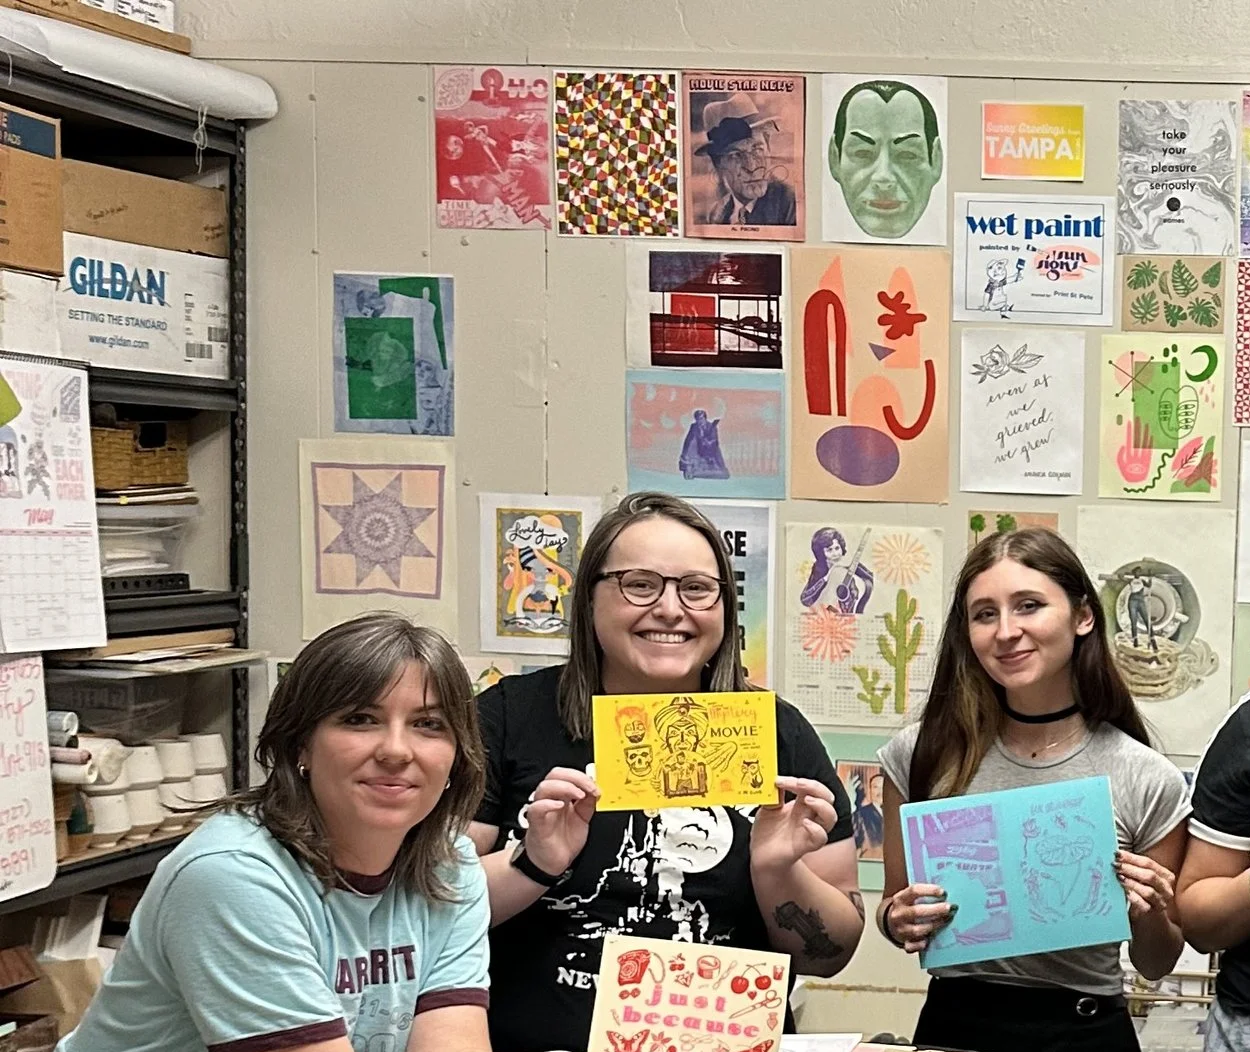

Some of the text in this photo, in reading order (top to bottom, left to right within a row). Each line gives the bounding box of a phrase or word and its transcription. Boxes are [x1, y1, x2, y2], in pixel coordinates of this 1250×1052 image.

[690, 79, 794, 92] MOVIE STAR NEWS
[1162, 129, 1186, 139] take
[986, 136, 1074, 160] TAMPA
[1162, 147, 1186, 156] your
[1151, 162, 1197, 174] pleasure
[445, 201, 471, 210] TIME
[966, 213, 1106, 240] wet paint
[69, 256, 165, 306] GILDAN
[68, 308, 168, 331] SETTING THE STANDARD
[88, 334, 149, 350] www.gildan.com
[986, 382, 1027, 406] even
[1006, 398, 1036, 419] we
[994, 448, 1018, 464] we
[510, 520, 556, 544] Lovely
[544, 537, 568, 553] day
[710, 725, 759, 738] MOVIE
[645, 983, 728, 1012] just
[623, 1005, 760, 1037] because
